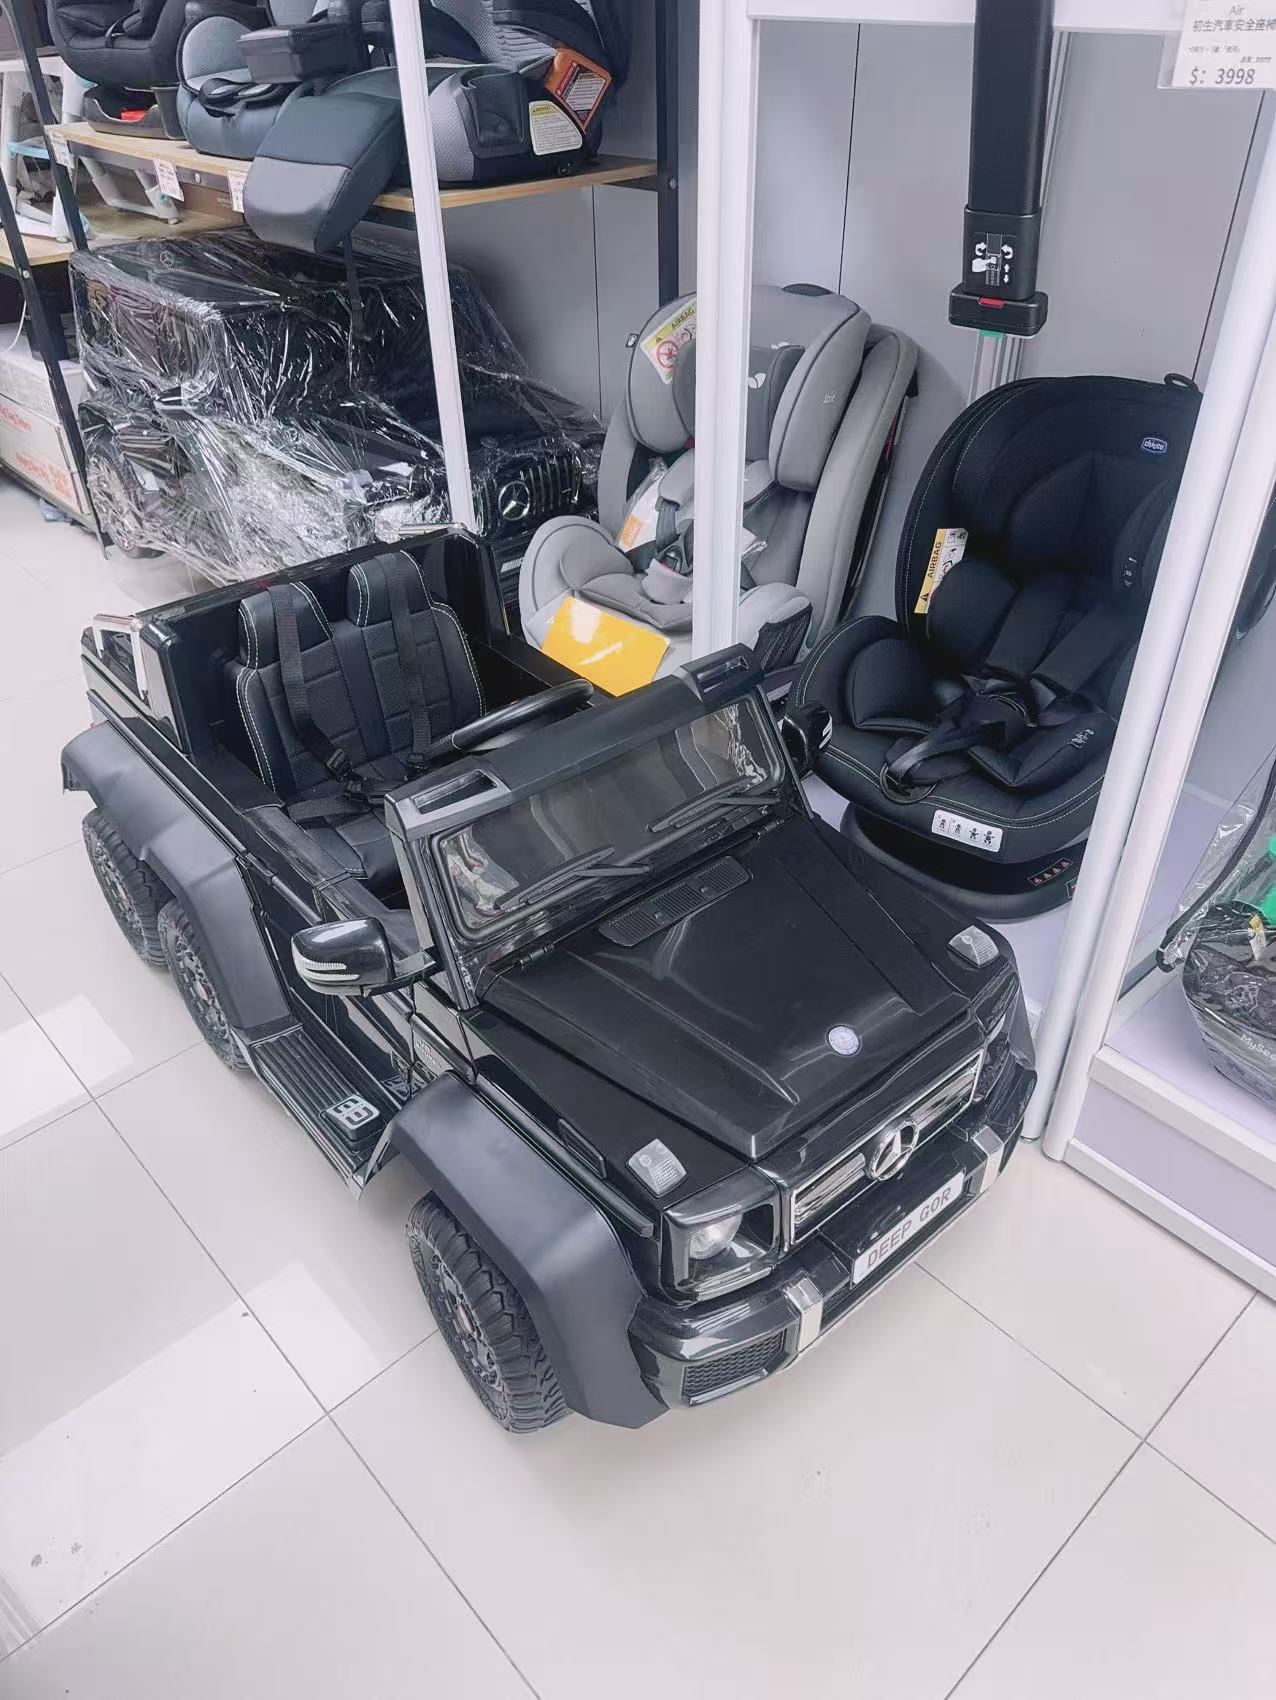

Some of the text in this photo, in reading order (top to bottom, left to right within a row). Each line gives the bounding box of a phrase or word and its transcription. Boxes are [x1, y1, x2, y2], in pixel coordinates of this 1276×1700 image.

[1229, 5, 1245, 15] Air
[1215, 68, 1255, 85] 3998
[671, 307, 695, 330] AIRBAG
[927, 541, 942, 578] AIRBAG
[867, 1219, 912, 1267] DEEP
